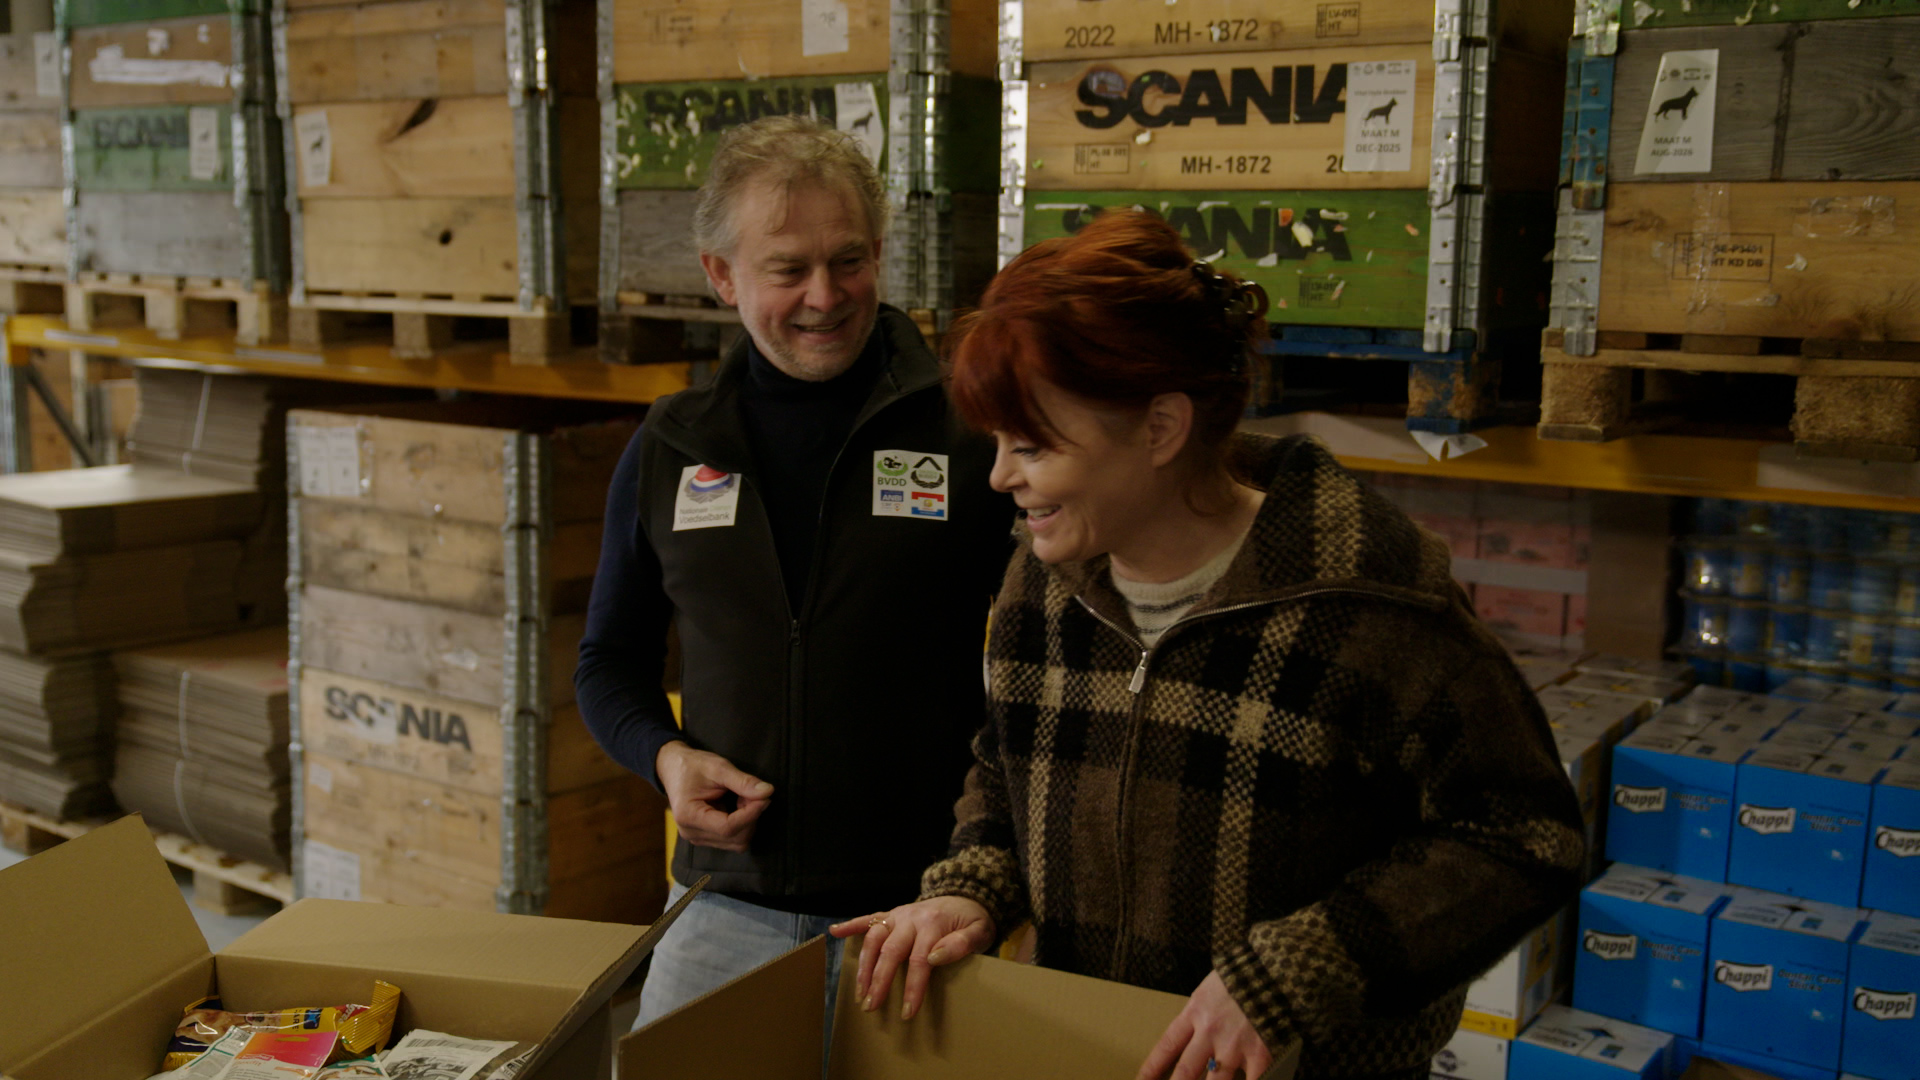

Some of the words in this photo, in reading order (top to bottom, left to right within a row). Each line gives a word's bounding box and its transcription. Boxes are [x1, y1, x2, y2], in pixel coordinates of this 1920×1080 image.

[1154, 19, 1259, 43] MH-1872
[1327, 20, 1341, 31] HT
[1064, 25, 1115, 48] 2022
[94, 114, 189, 150] SCANI
[1355, 144, 1401, 153] DEC-2025
[1181, 155, 1272, 174] MH-1872
[877, 477, 907, 486] BVDD
[326, 686, 473, 751] SCNIA
[1614, 789, 1664, 808] Chappi
[1738, 809, 1792, 829] Chappi
[1583, 935, 1633, 956] Chappi
[1714, 965, 1769, 985] Chappi
[1853, 992, 1914, 1015] Chappi
